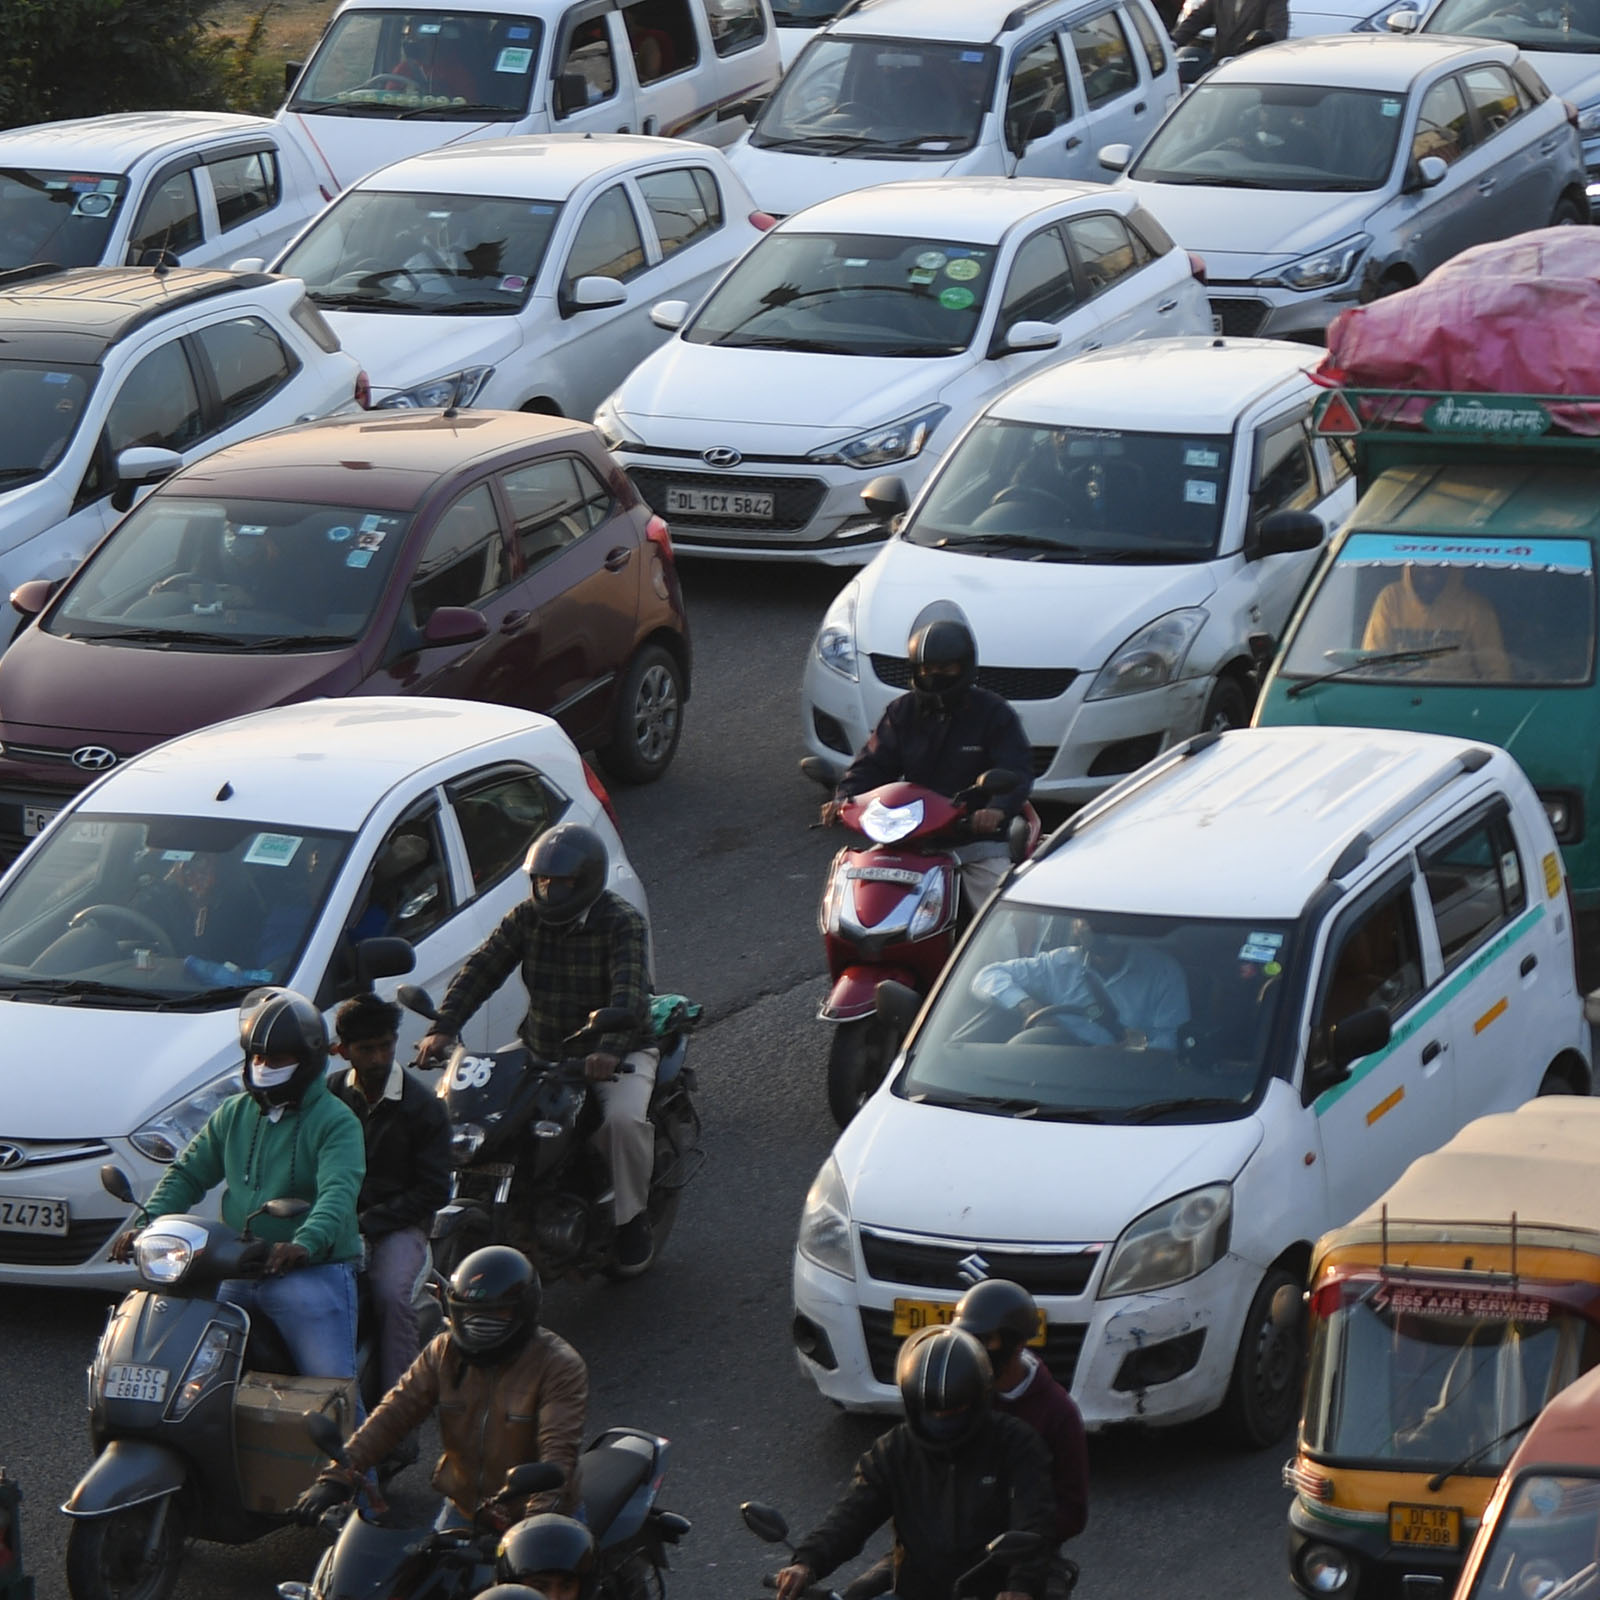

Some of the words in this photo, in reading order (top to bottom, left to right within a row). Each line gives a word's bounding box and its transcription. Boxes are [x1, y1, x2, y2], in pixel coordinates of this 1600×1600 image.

[678, 493, 697, 511] DL
[702, 494, 729, 512] 1CX
[734, 496, 772, 516] 5842
[1391, 1294, 1423, 1307] ESS
[1427, 1296, 1463, 1309] AAR
[1467, 1299, 1551, 1314] SERVICES
